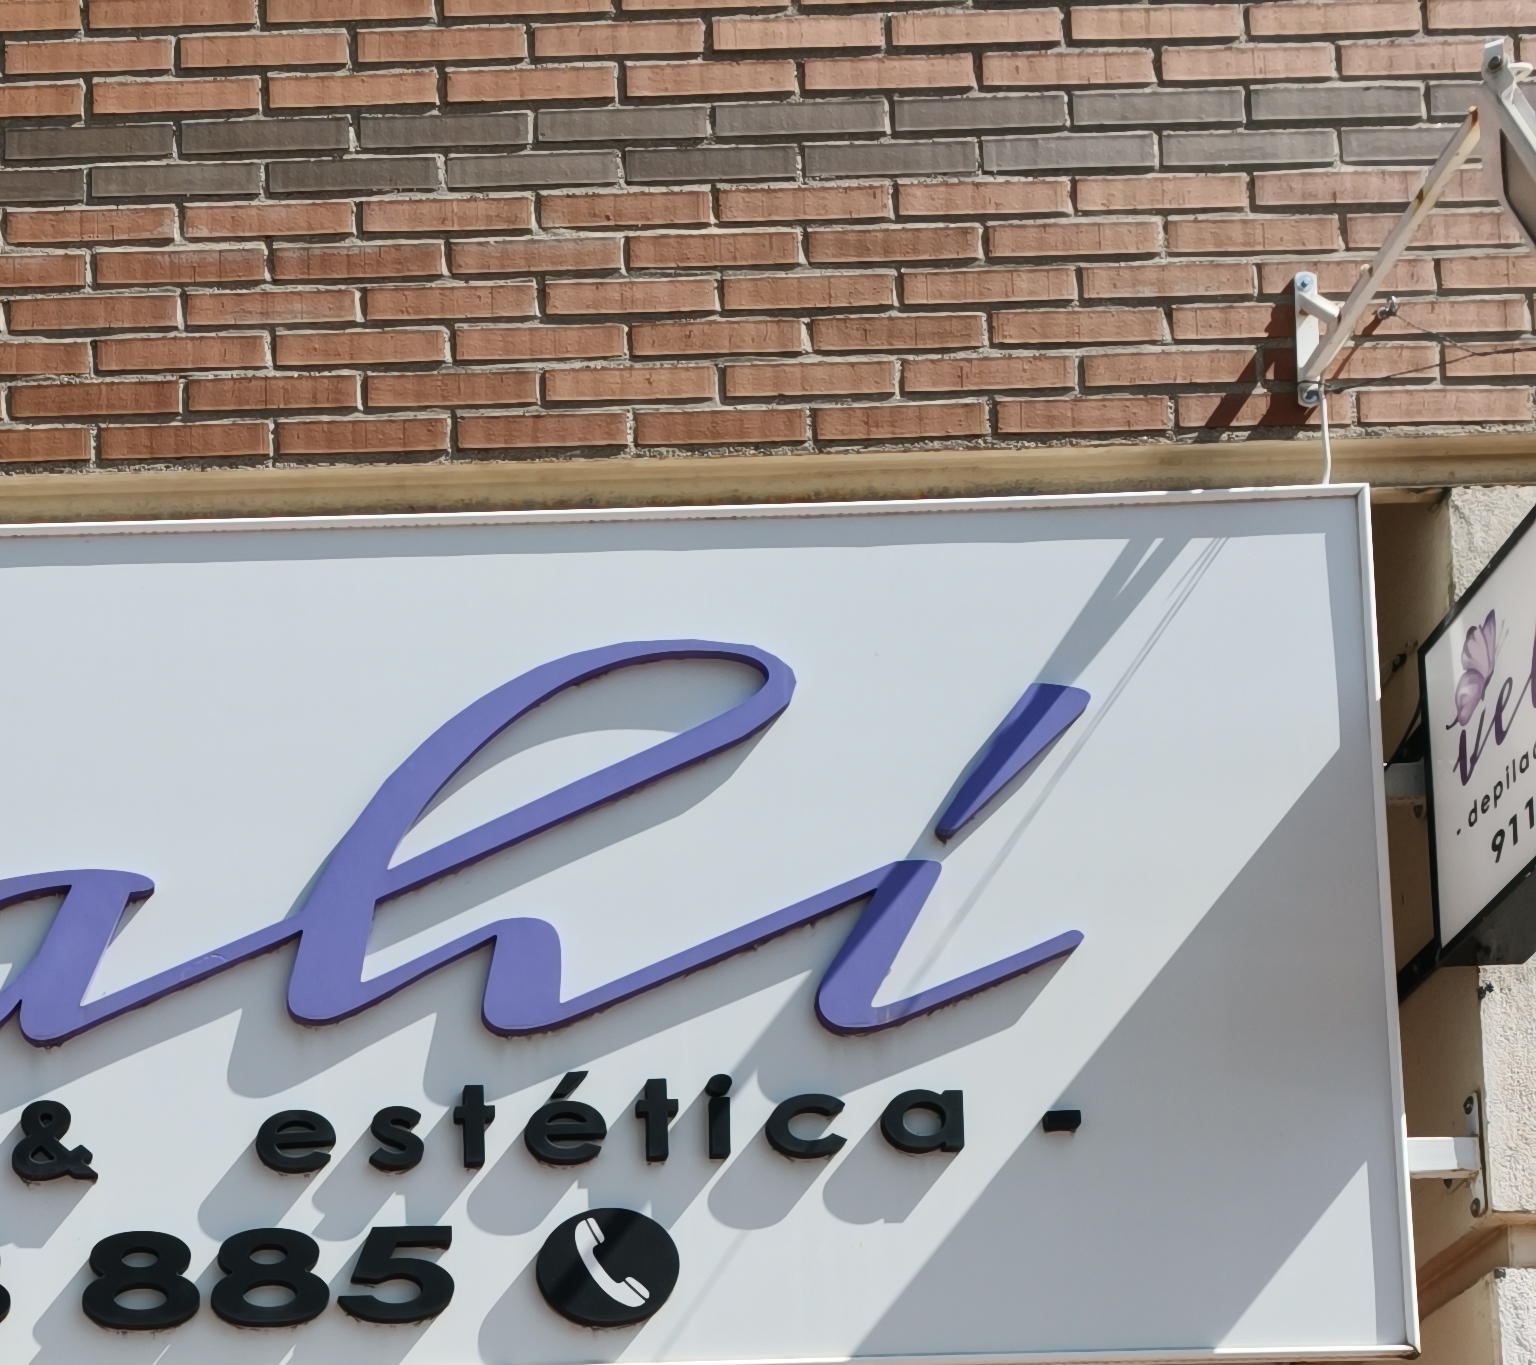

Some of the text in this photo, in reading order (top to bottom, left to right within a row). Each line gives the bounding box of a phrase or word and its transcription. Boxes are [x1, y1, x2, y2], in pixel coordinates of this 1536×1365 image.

[1490, 796, 1535, 864] 911
[11, 1100, 98, 1183] &
[255, 1070, 966, 1175] estética
[80, 1224, 457, 1333] 885
